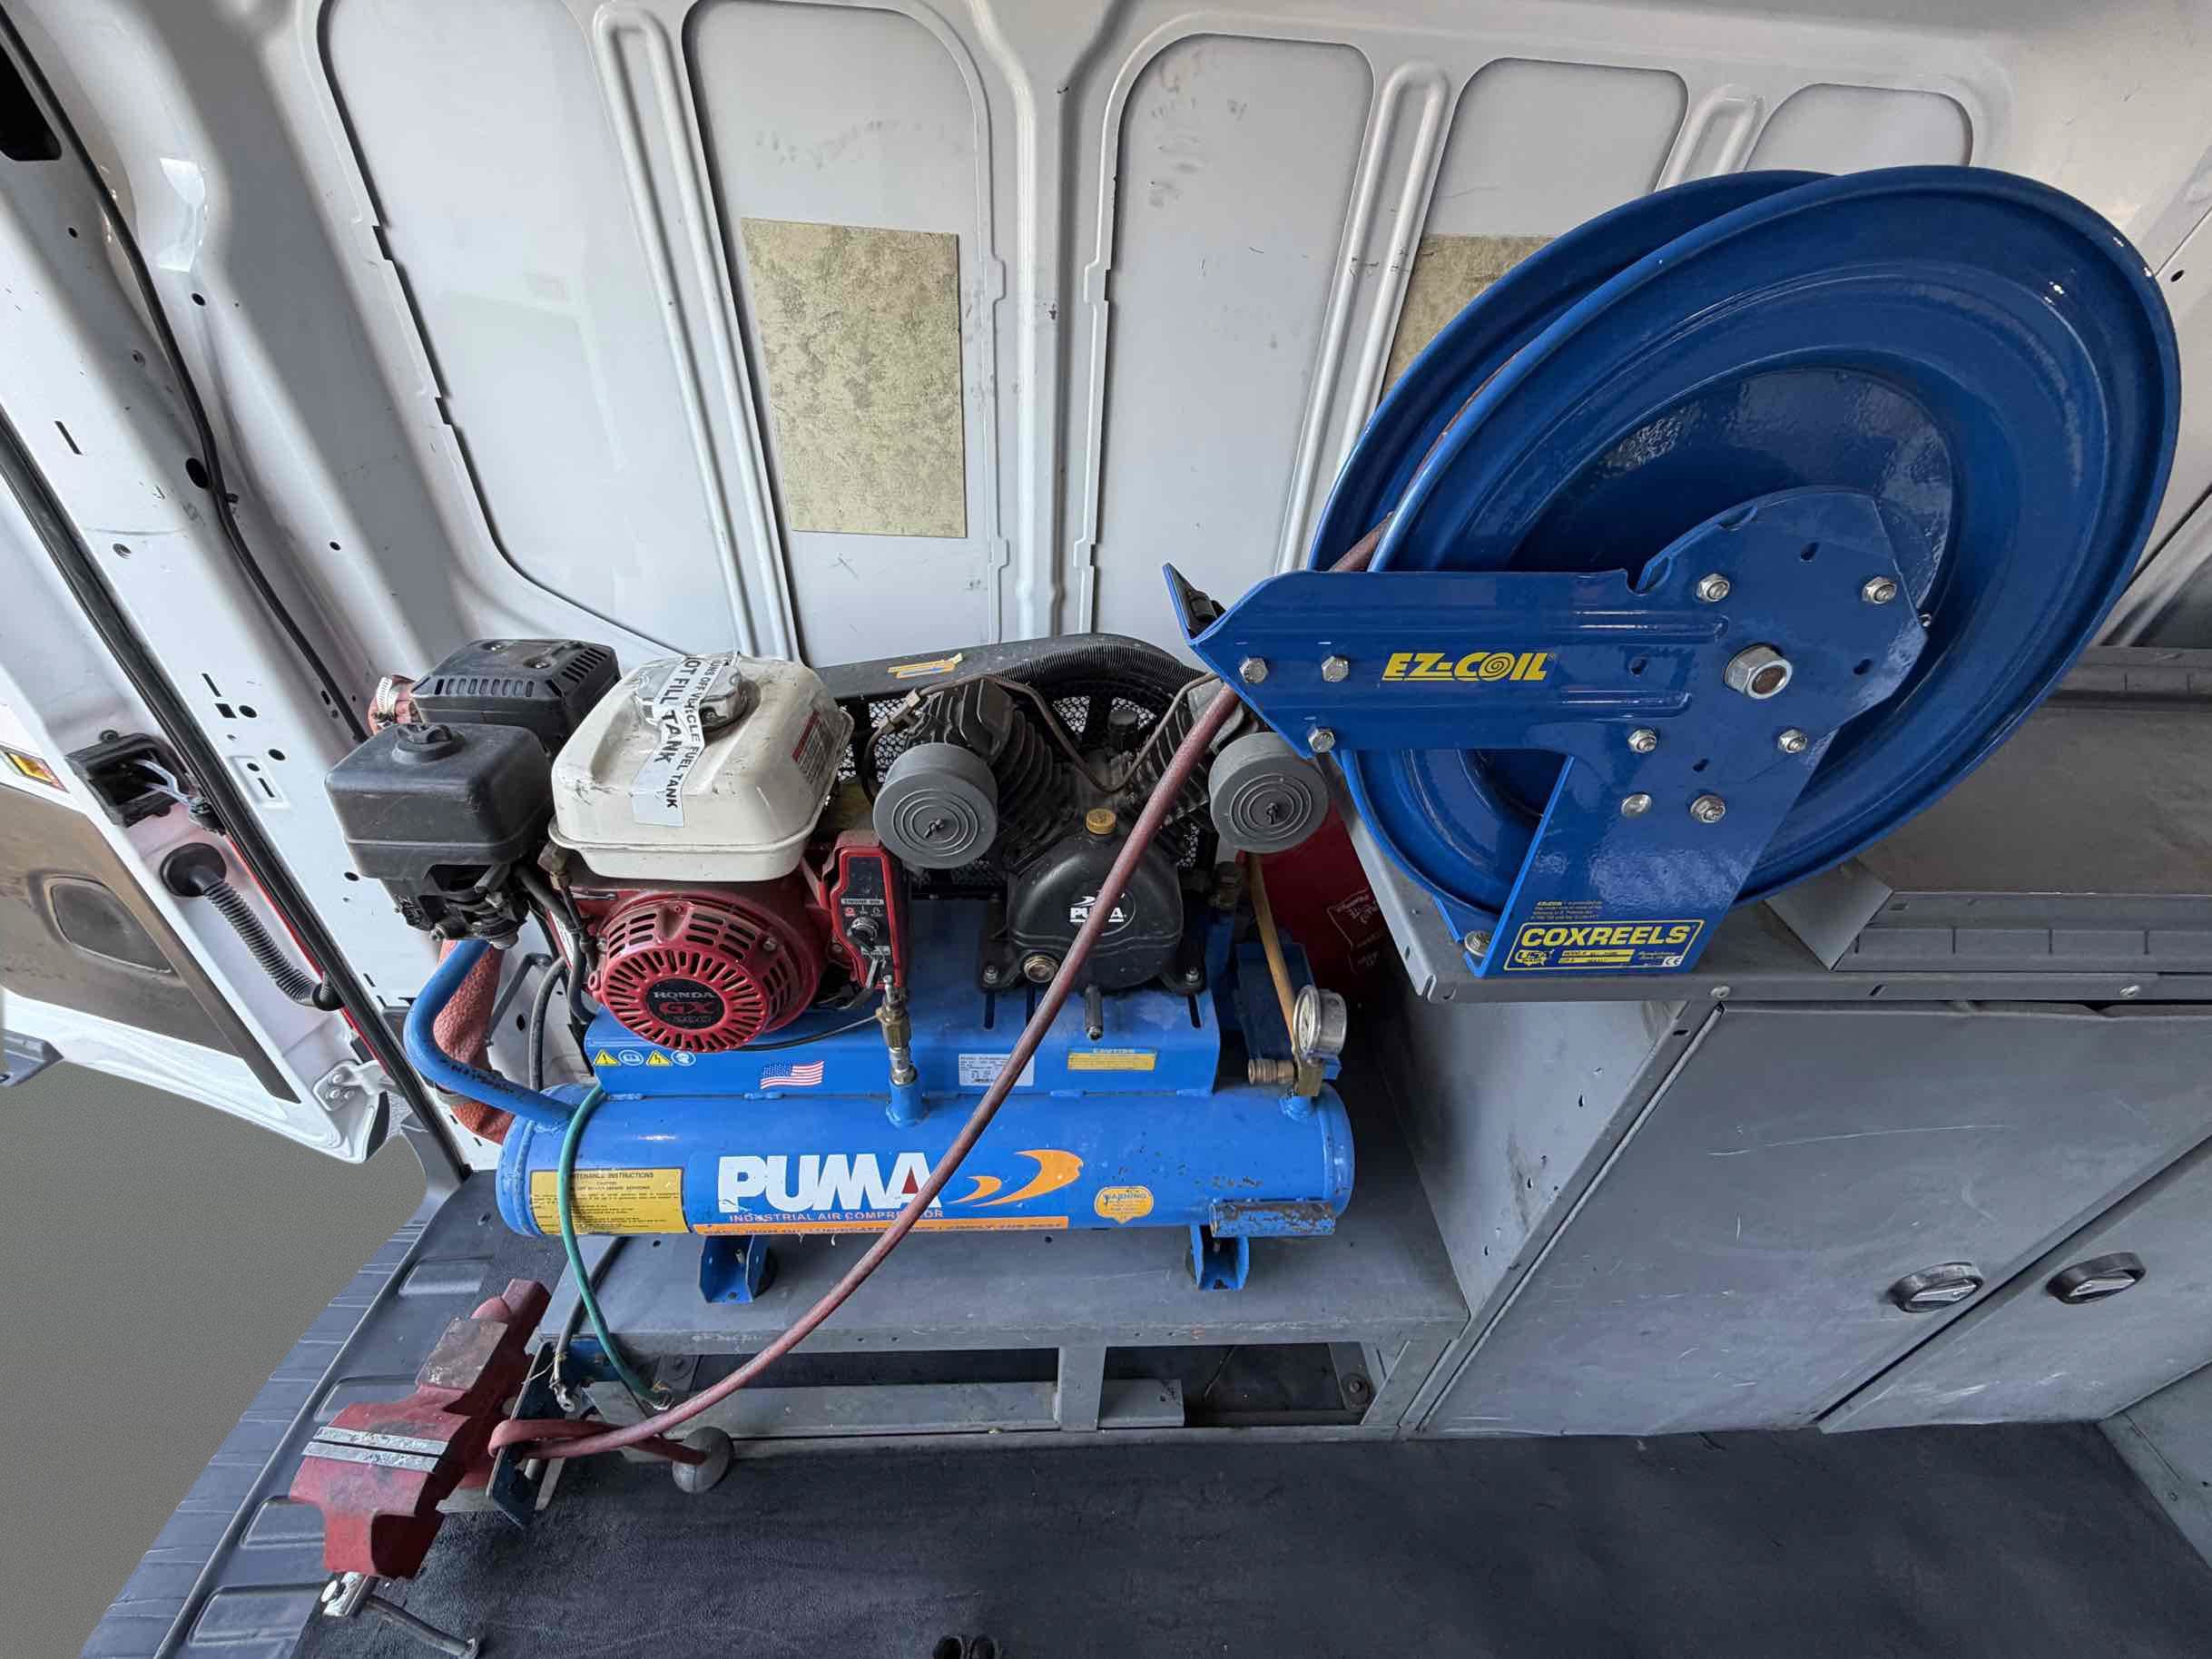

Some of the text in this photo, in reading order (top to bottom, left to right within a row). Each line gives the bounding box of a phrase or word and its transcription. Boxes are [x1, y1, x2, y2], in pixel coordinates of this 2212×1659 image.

[1382, 652, 1548, 682] EZ-COIL
[659, 678, 691, 704] FILL
[654, 710, 683, 762] TANK
[676, 746, 700, 771] FUEL
[665, 773, 683, 809] TANK
[1069, 907, 1125, 918] PUA
[1521, 926, 1691, 947] COXREELS
[654, 991, 715, 999] HONDA
[659, 1001, 713, 1015] GX
[718, 1153, 942, 1213] PUMA
[730, 1210, 943, 1222] INDUSTRIAL AIR COMPROR
